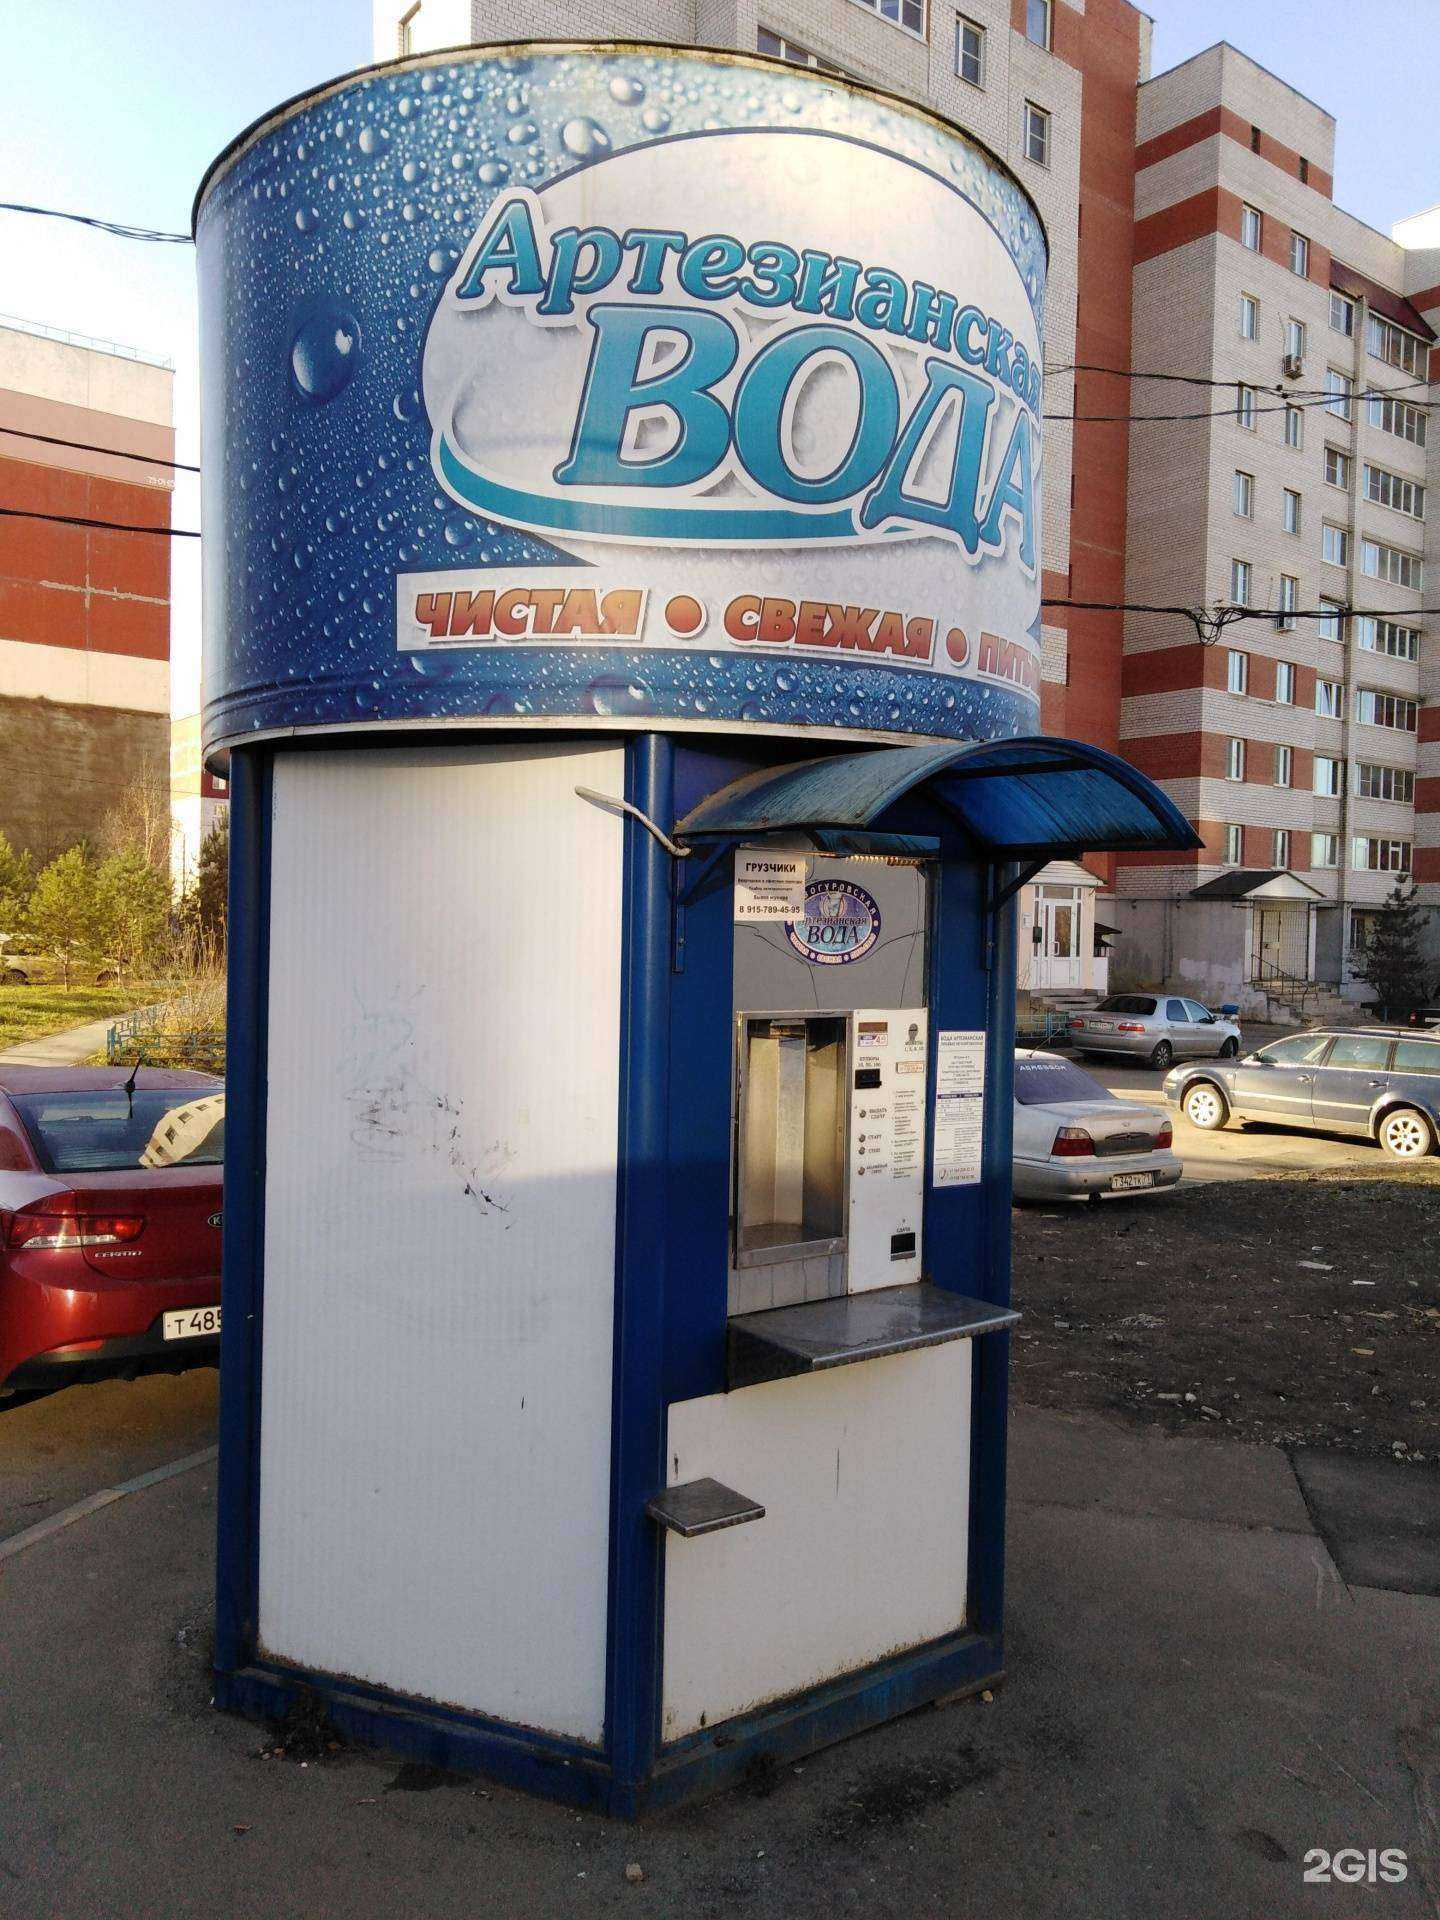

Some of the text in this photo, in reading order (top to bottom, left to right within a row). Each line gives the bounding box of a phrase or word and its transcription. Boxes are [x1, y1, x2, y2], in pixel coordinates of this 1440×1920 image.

[455, 198, 1041, 424] Артезианская
[552, 302, 1037, 571] ВОДА
[414, 588, 643, 637] ЧИСТАЯ
[724, 595, 936, 661] СВЕЖАЯ
[745, 862, 796, 873] ГРУЗЧИКИ
[738, 905, 801, 914] 8 915-789-45-95
[807, 925, 859, 945] ВОДА
